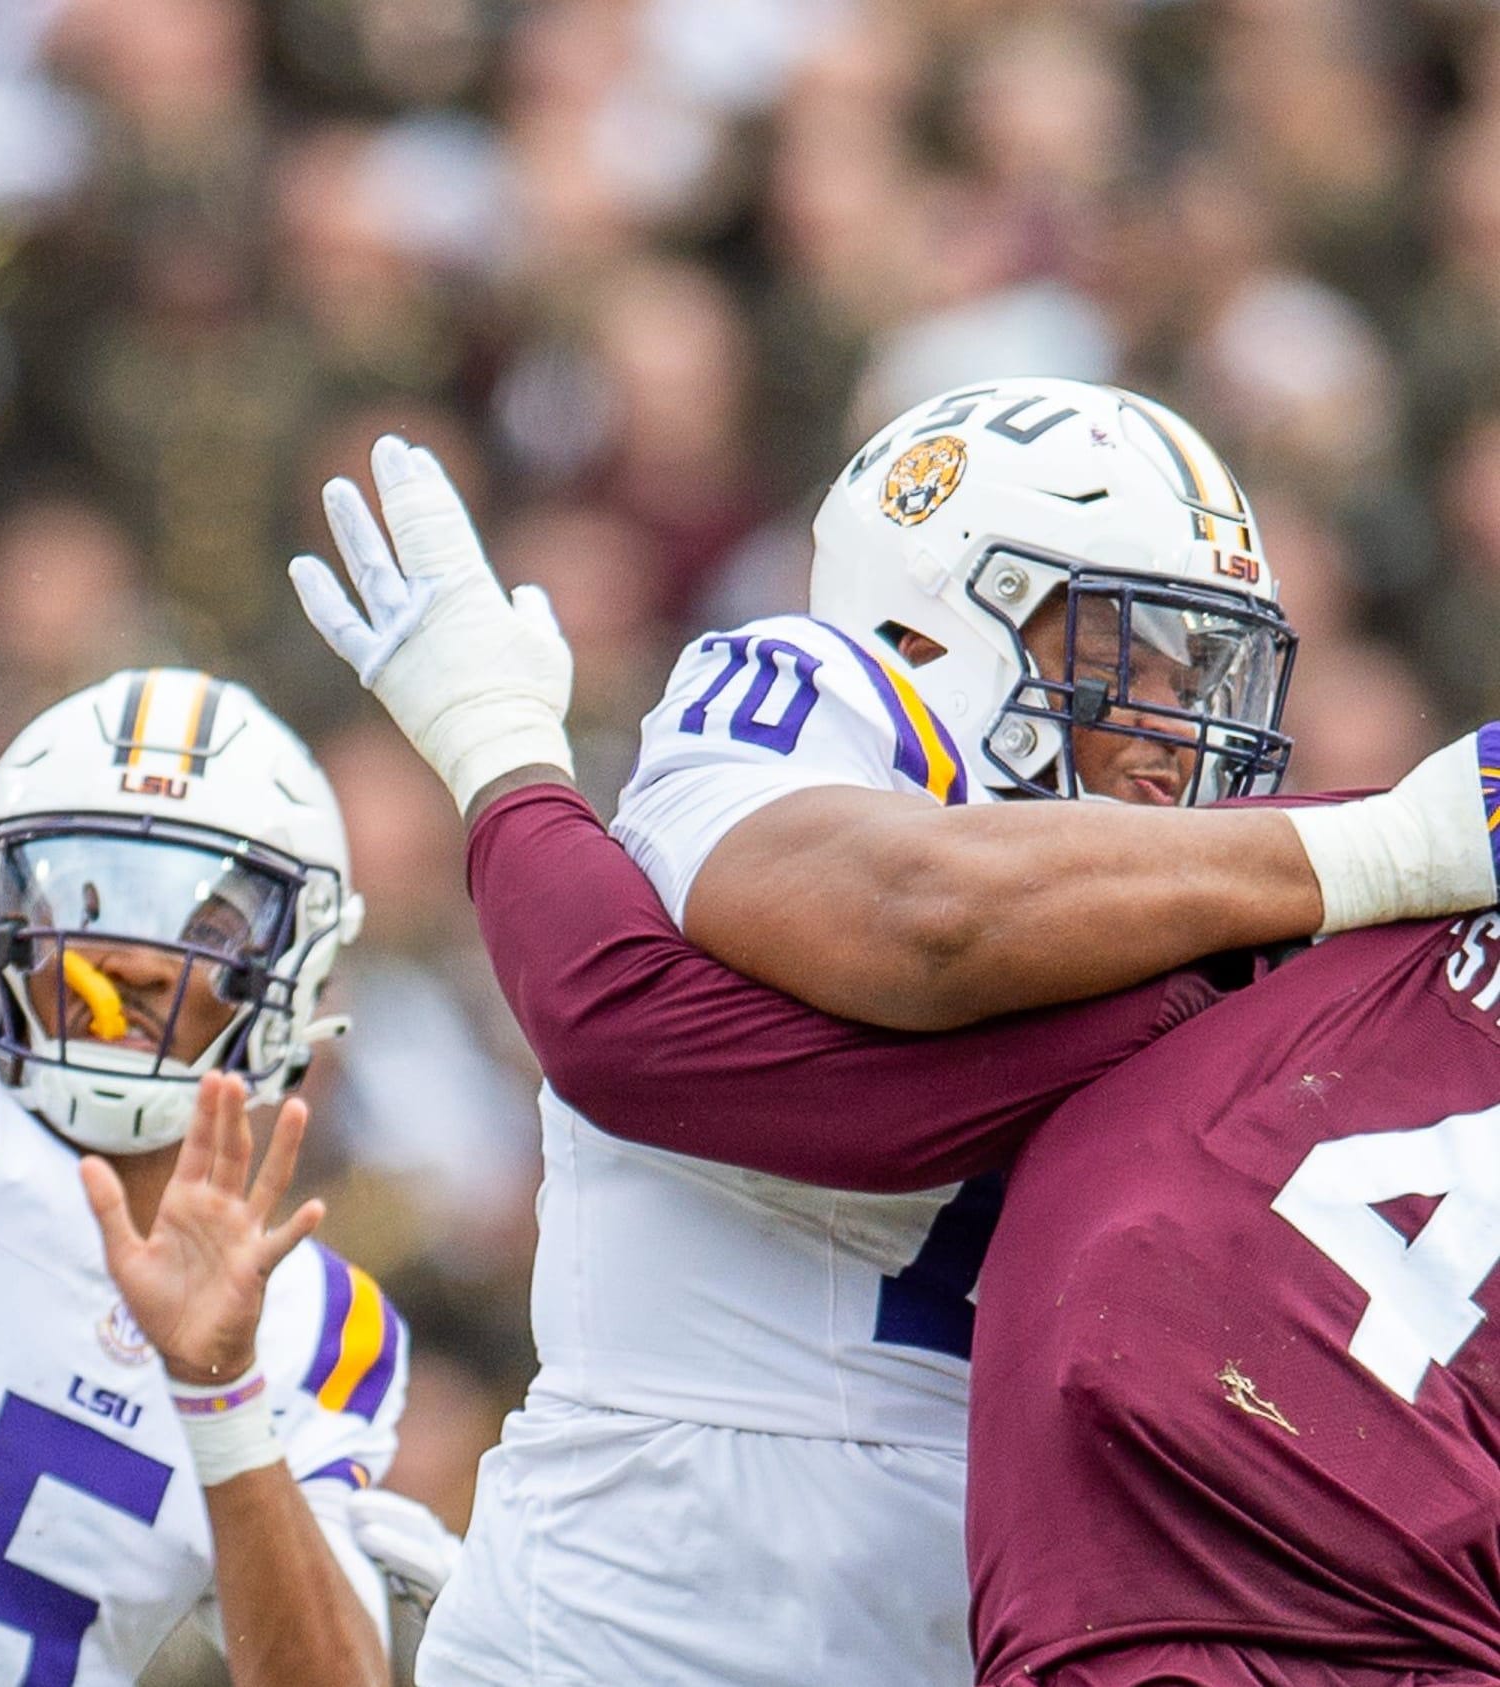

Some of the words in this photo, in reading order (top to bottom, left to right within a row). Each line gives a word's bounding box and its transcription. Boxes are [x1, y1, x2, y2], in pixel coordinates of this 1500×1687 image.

[1213, 549, 1260, 585] LSU
[678, 635, 824, 757] 70
[120, 772, 188, 800] LSU
[67, 1375, 143, 1429] LSU
